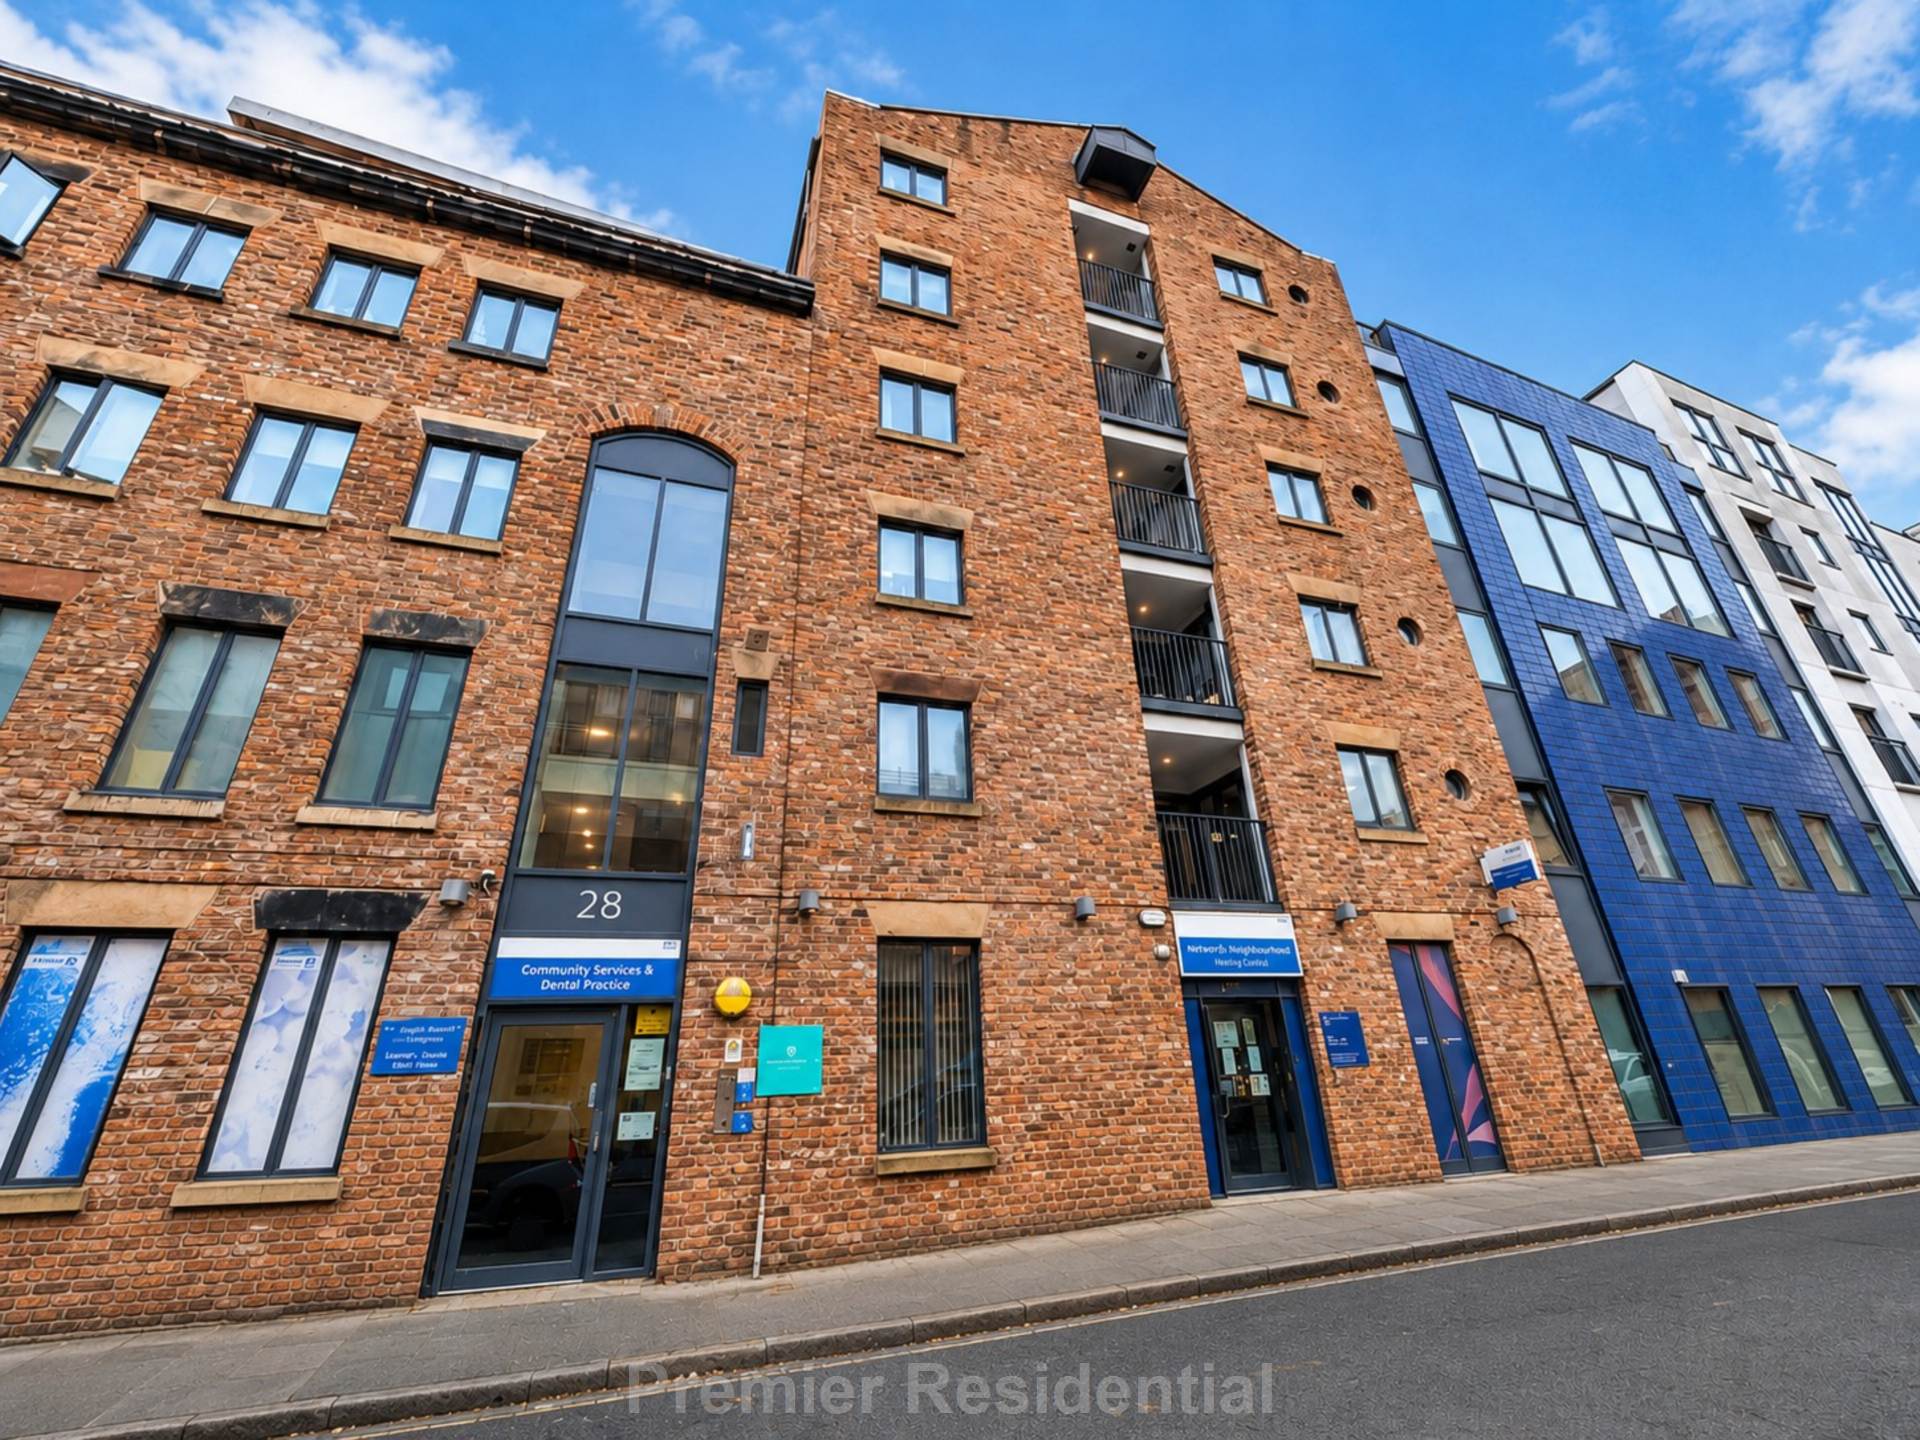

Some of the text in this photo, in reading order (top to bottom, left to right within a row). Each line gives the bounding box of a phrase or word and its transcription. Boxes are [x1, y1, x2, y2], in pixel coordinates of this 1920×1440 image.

[576, 890, 622, 919] 28
[521, 964, 654, 977] Community Services &
[541, 979, 631, 990] Dental Practice
